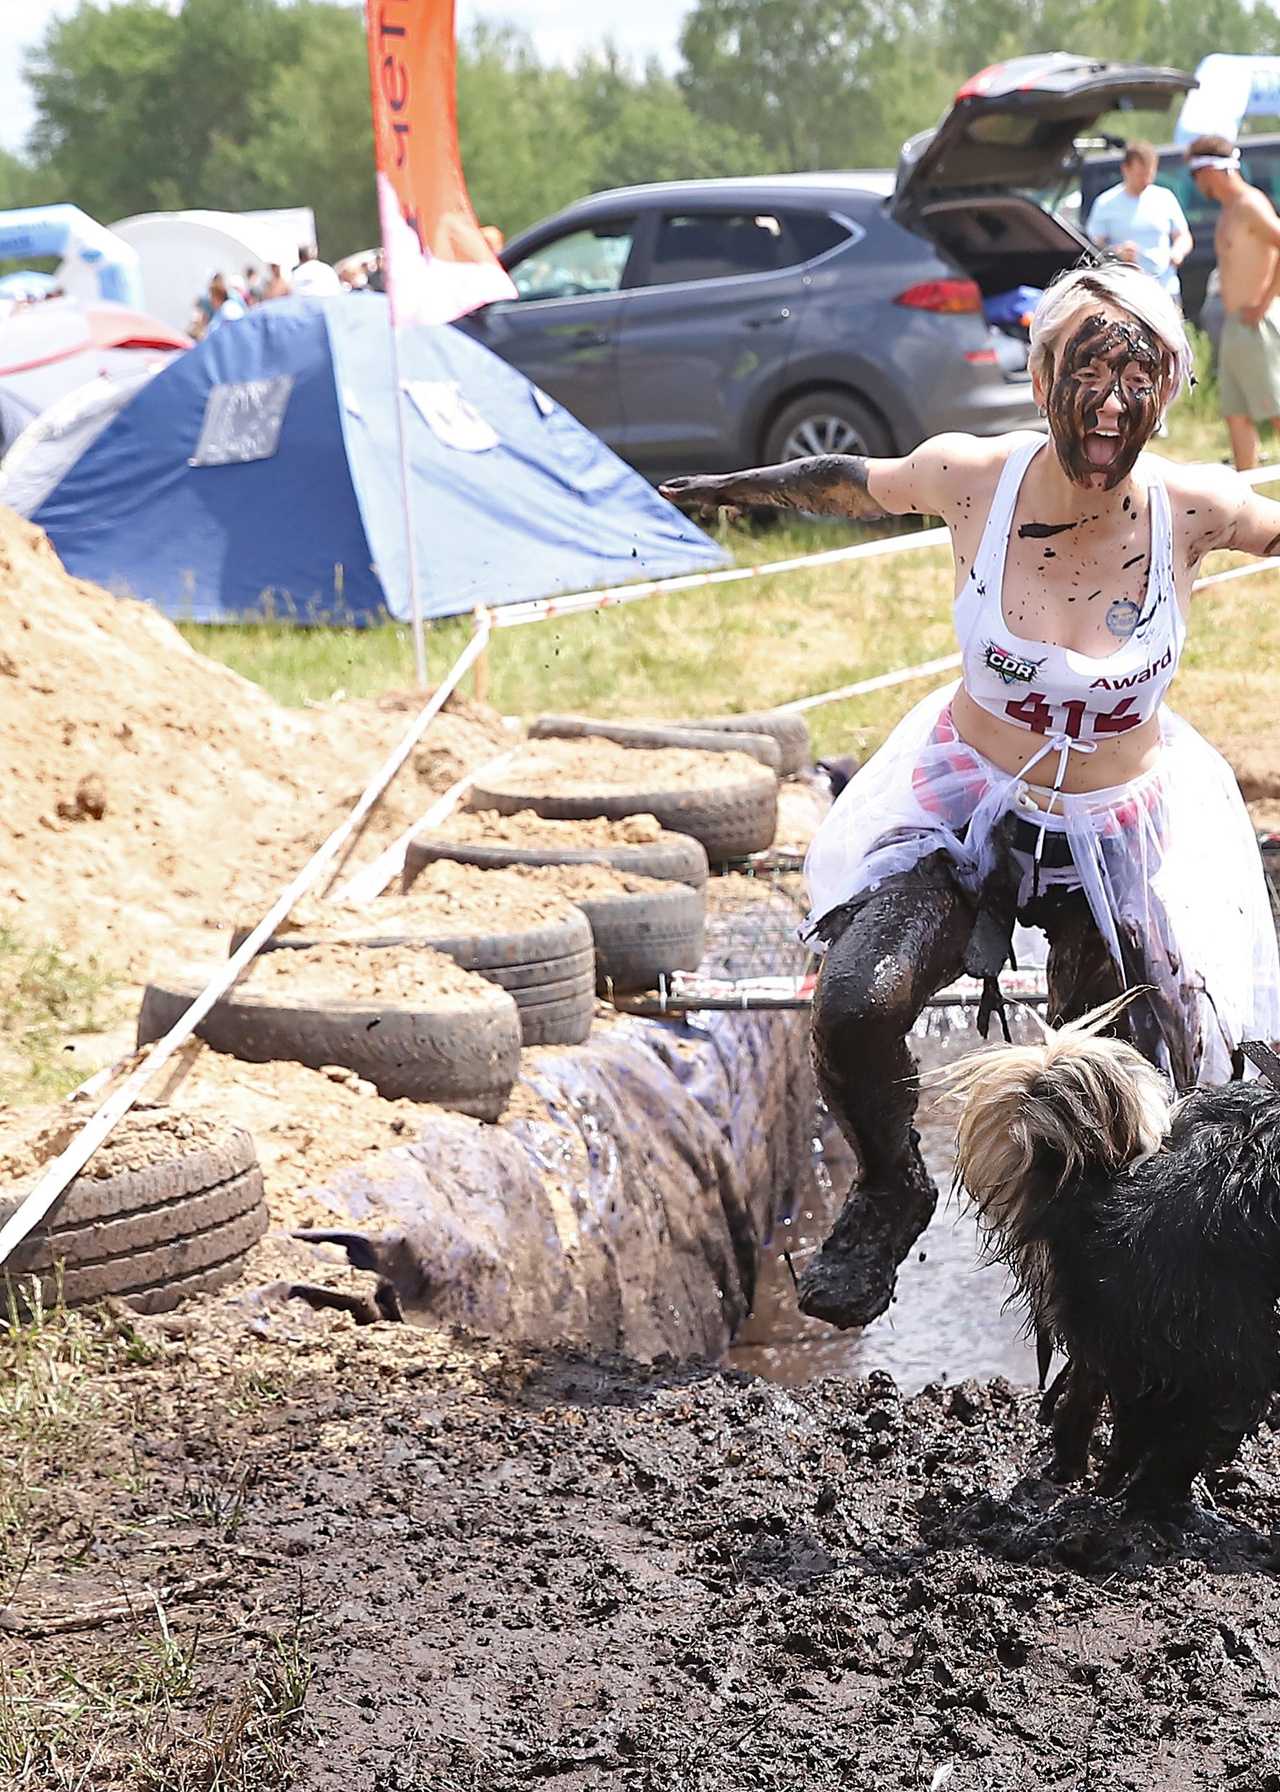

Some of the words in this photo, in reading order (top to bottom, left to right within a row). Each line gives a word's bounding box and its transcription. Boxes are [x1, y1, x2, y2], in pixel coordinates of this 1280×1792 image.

[989, 652, 1033, 678] CDR
[1089, 646, 1172, 690] Award
[1004, 691, 1142, 739] 414
